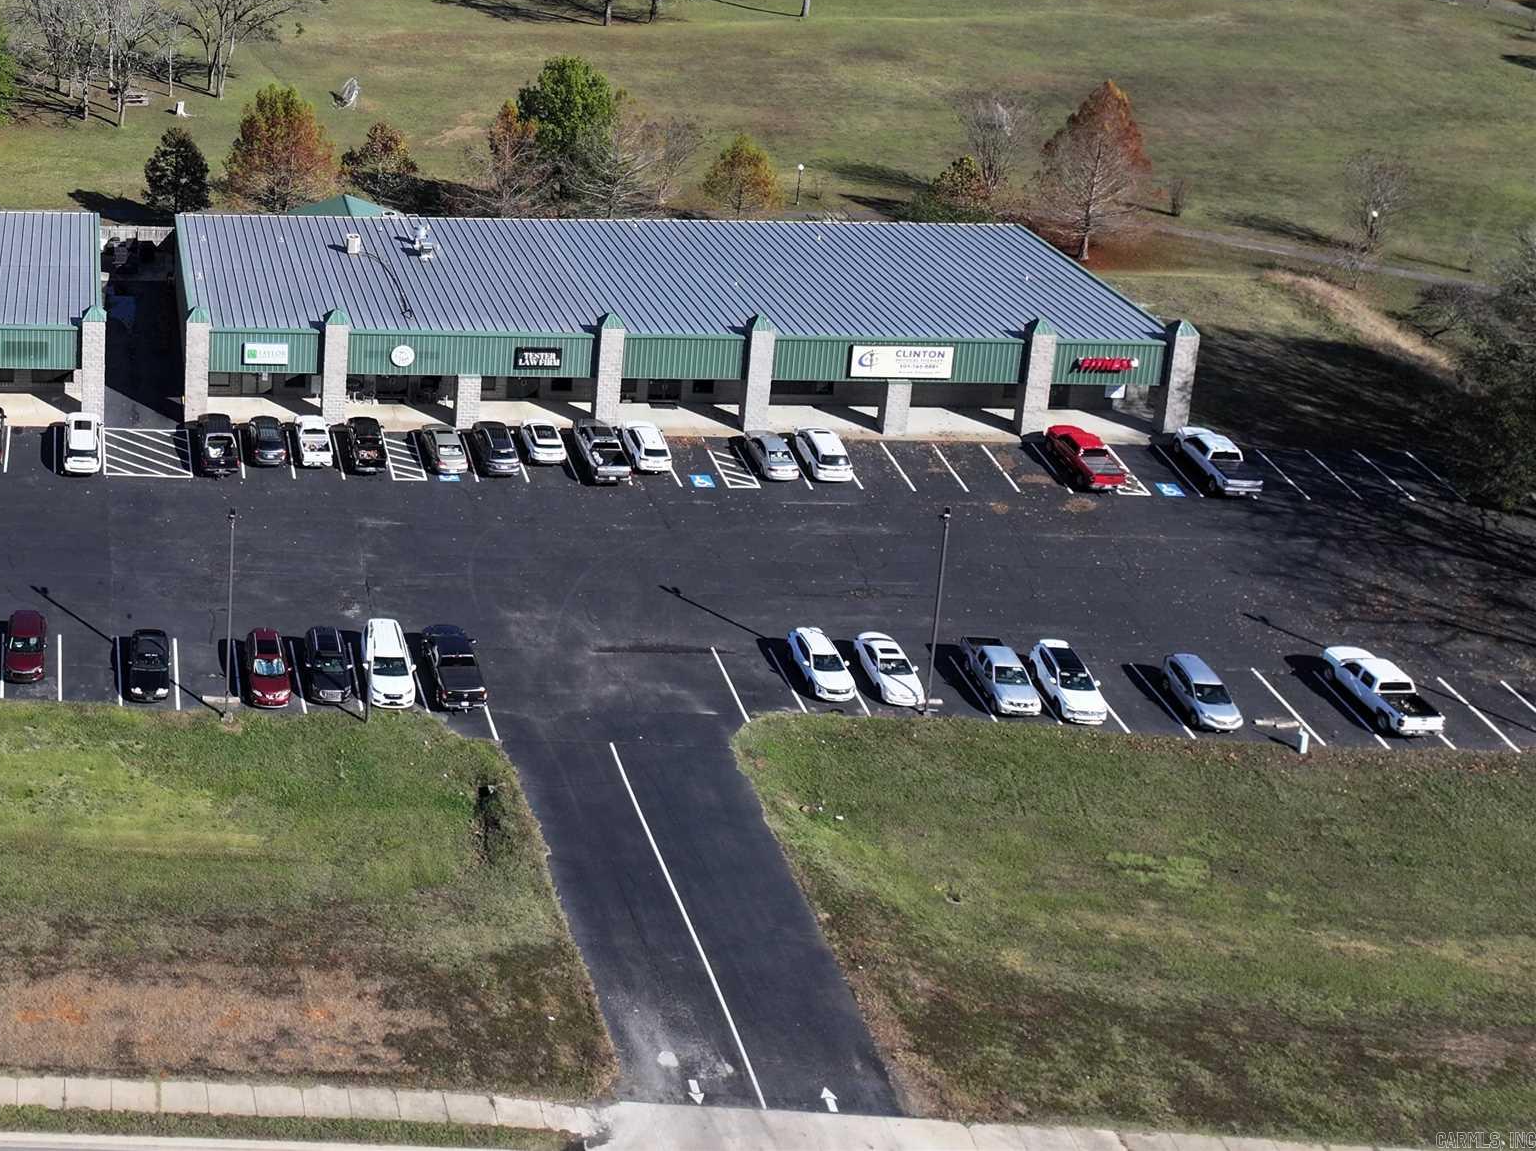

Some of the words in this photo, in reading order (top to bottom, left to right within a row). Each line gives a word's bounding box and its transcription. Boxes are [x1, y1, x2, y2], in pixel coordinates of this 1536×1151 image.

[523, 352, 557, 360] TESTER
[895, 349, 945, 358] CLINTON
[518, 358, 539, 366] LAW
[539, 358, 561, 367] FIRM
